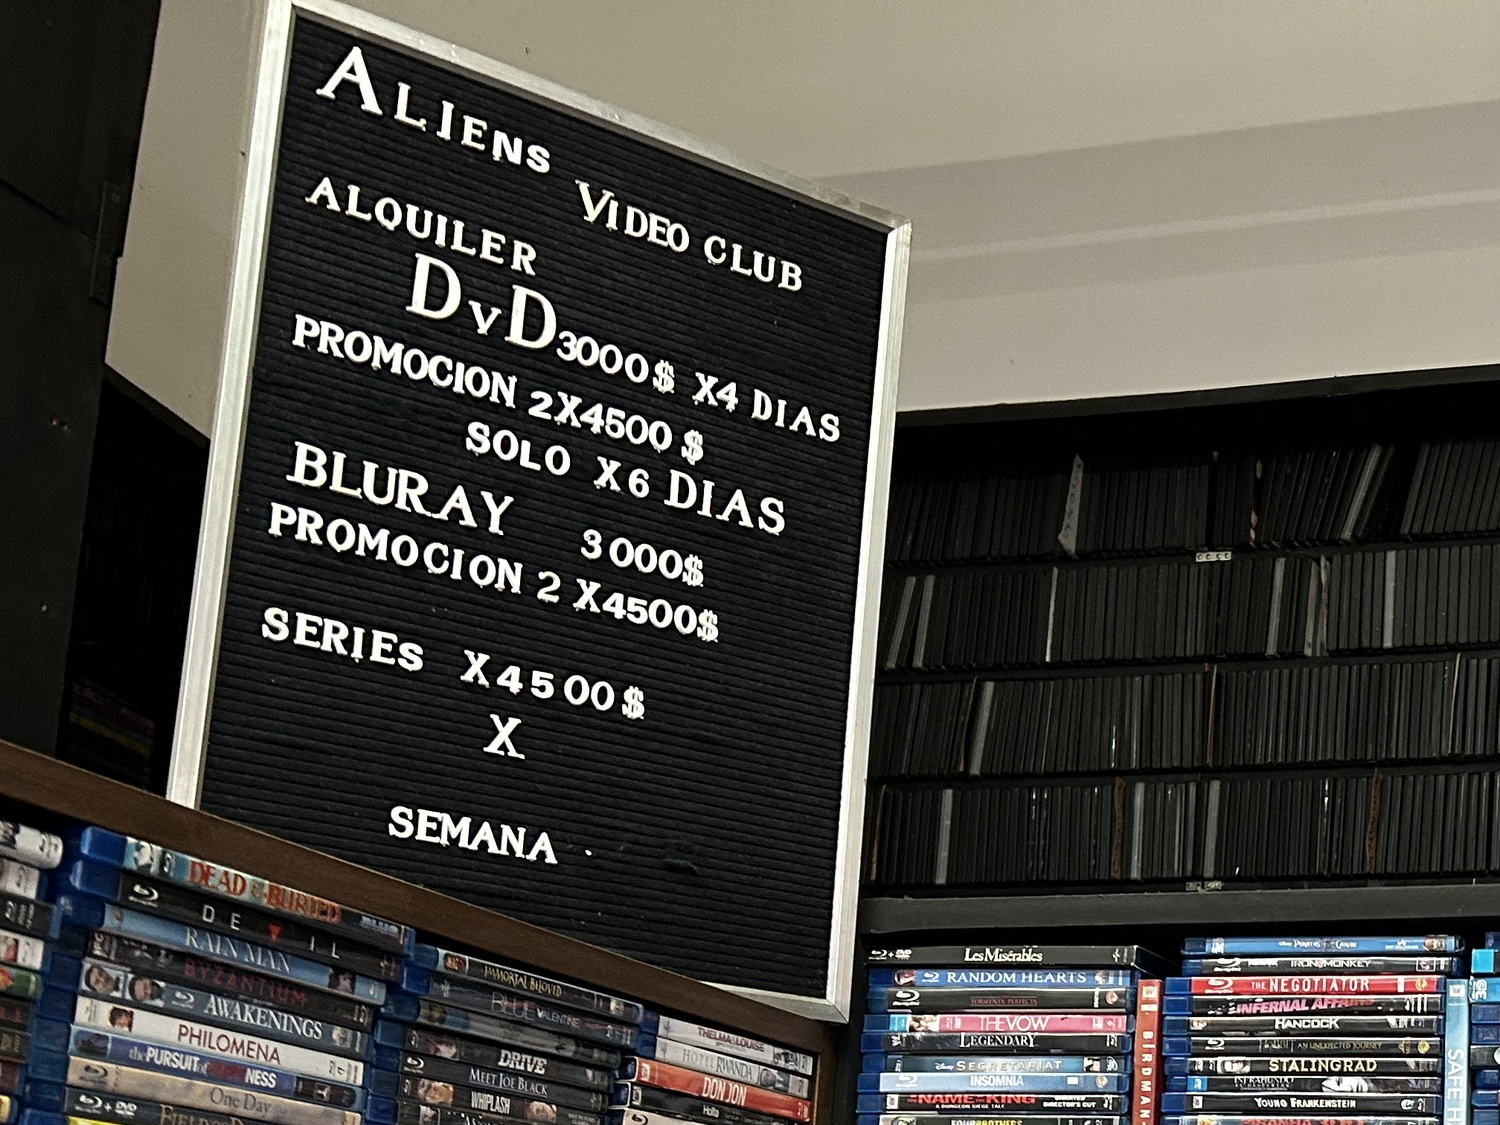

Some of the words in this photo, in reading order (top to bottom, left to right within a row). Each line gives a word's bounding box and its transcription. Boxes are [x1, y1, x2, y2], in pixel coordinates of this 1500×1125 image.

[316, 46, 551, 174] ALIENS
[576, 180, 689, 254] VIDEO
[704, 236, 802, 292] CLUB
[305, 177, 538, 275] ALQUILER
[292, 315, 516, 410] PROMOCION
[557, 331, 675, 394] 3000$
[692, 372, 739, 410] X4
[751, 390, 841, 442] DIAS
[286, 442, 514, 538] BLURAY
[466, 420, 571, 476] SOLO
[594, 455, 650, 499] X6
[664, 469, 786, 536] DIAS
[269, 502, 522, 594] PROMOCION
[261, 608, 424, 672] SERIES
[482, 714, 525, 761] X
[388, 805, 559, 866] SEMANA
[947, 971, 1015, 983] RANDOM
[1025, 971, 1087, 983] HEARTS
[1269, 978, 1370, 992] NEGOTIATOR
[177, 1024, 281, 1065] PHILOMENA
[203, 994, 323, 1039] AWAKENINGS
[498, 1050, 548, 1075] DRIVE
[702, 1076, 725, 1101] DON
[727, 1081, 746, 1105] JON
[1268, 1059, 1378, 1072] STALINGRAD
